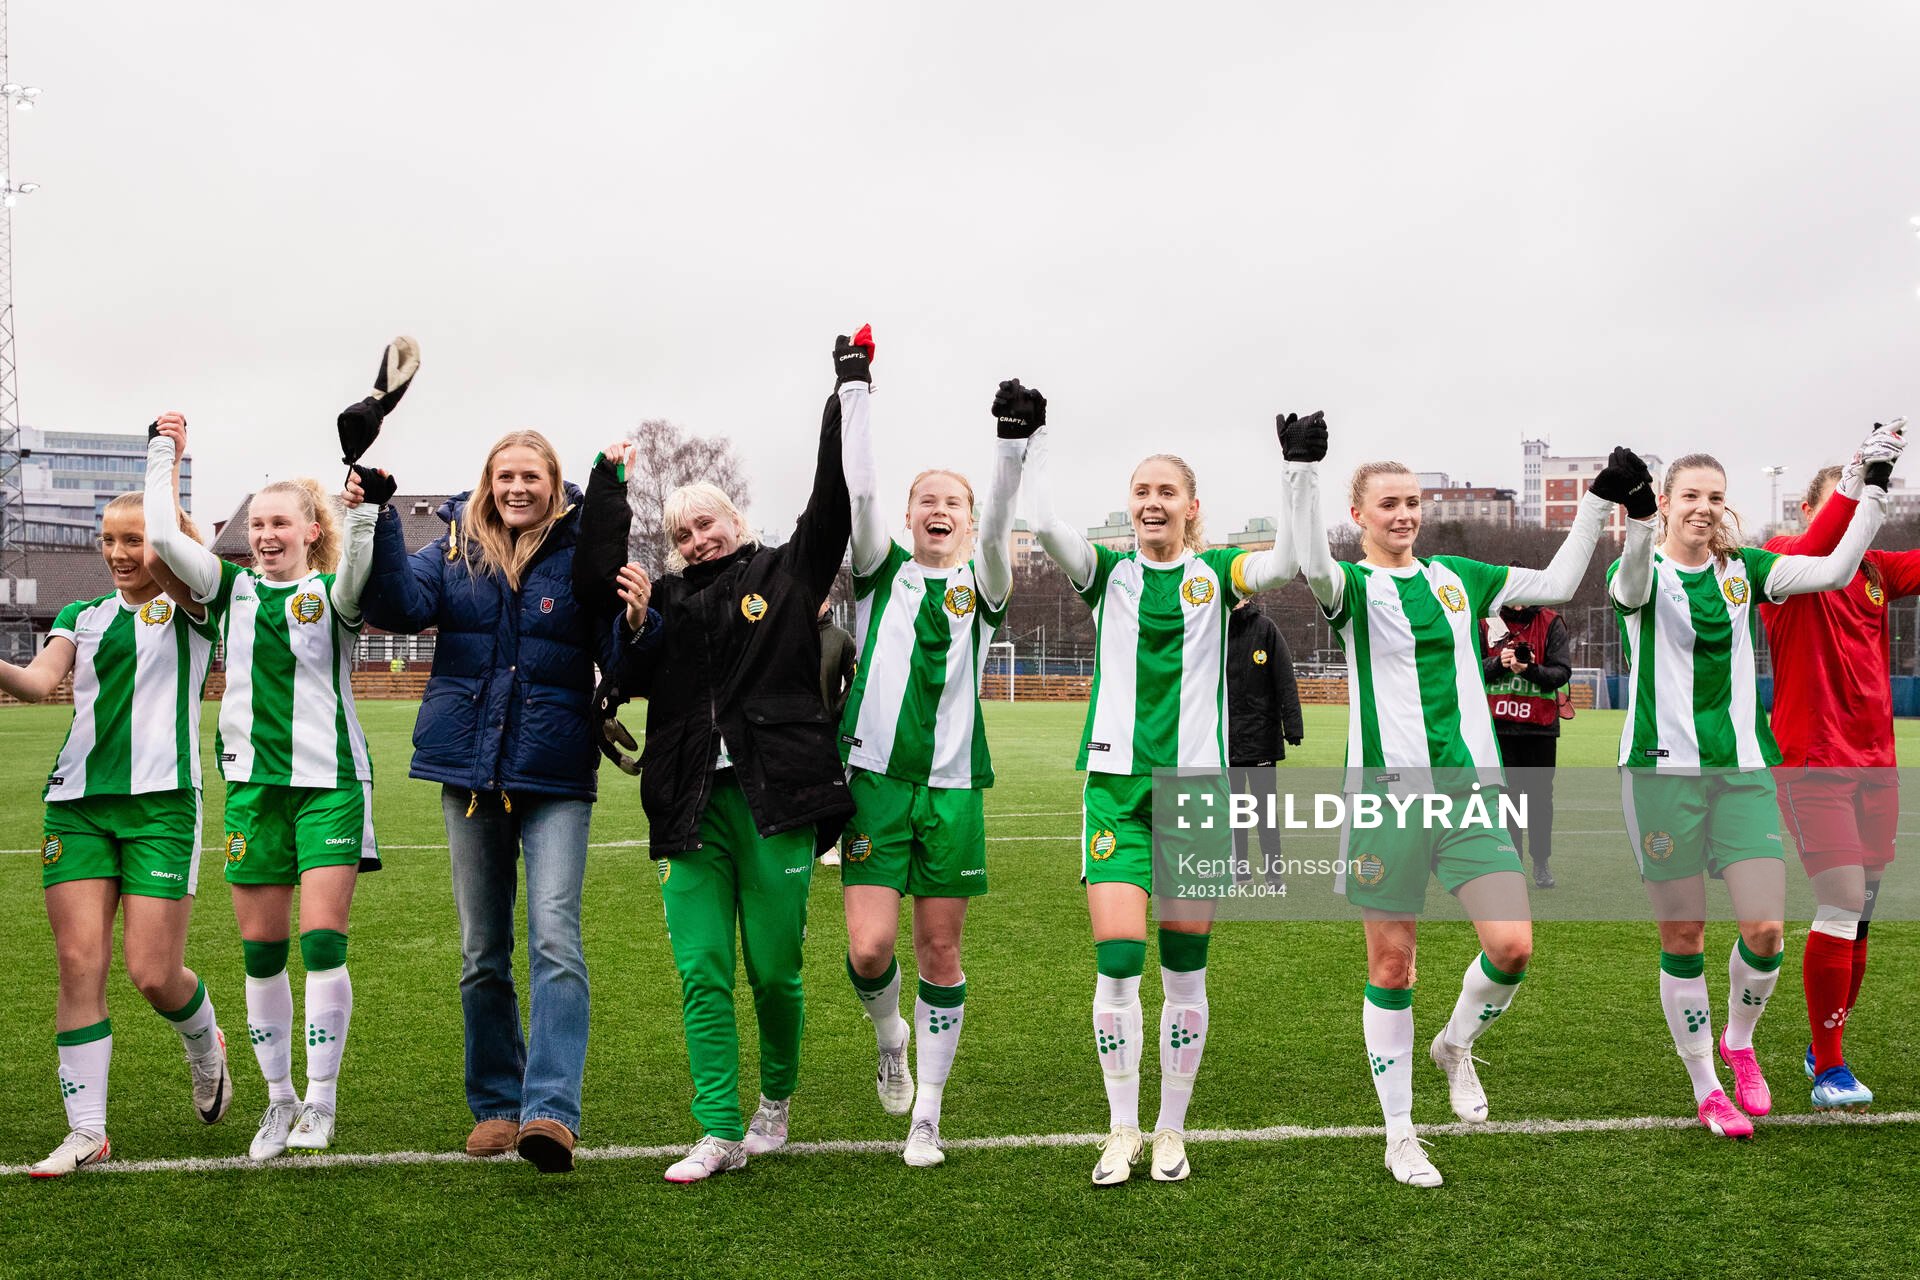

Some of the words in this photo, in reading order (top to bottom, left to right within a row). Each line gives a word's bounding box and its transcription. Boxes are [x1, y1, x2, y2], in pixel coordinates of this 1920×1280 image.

[839, 353, 860, 361] CRAFT
[1000, 416, 1021, 424] CRAFT
[898, 577, 918, 591] CRAFT
[1495, 700, 1531, 718] 008
[785, 866, 806, 874] CRAFT
[151, 871, 178, 880] CRAFT
